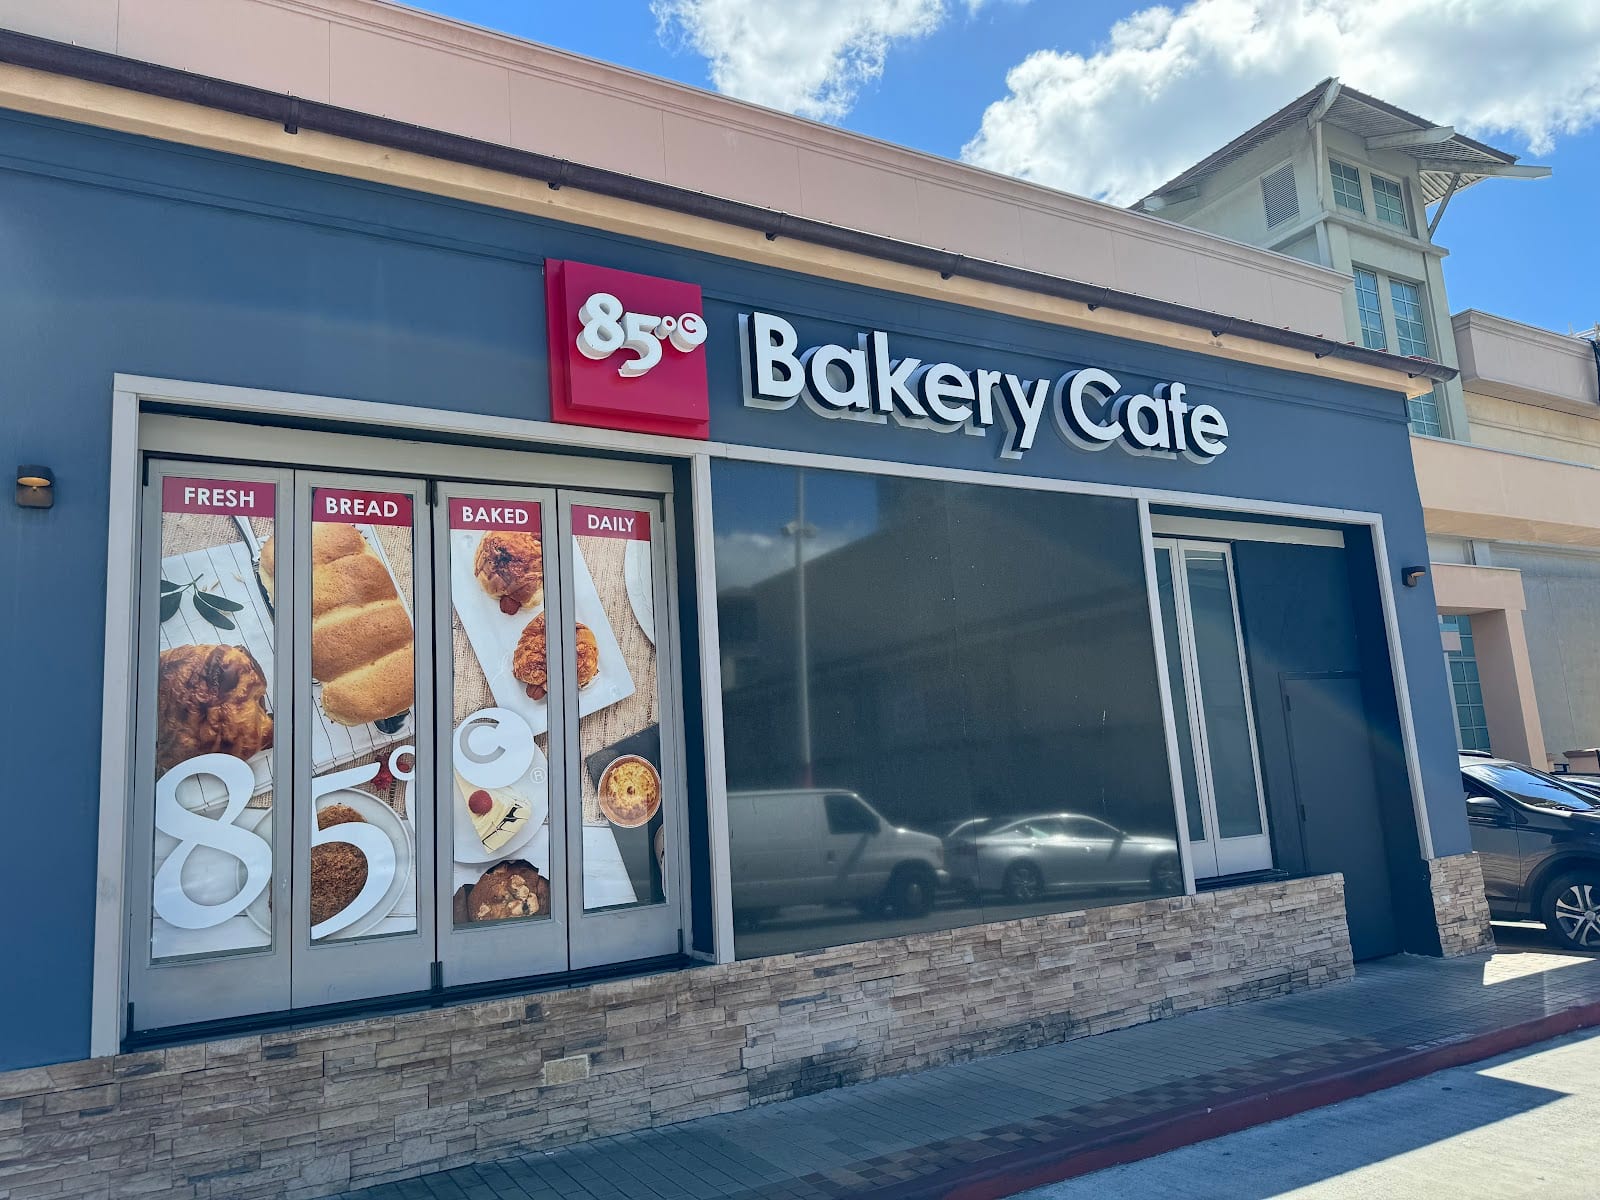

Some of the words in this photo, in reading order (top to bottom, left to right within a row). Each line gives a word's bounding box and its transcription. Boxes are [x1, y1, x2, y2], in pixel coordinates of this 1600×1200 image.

[747, 311, 1050, 452] Bakery
[1065, 367, 1229, 457] Cafe
[184, 487, 255, 508] FRESH
[325, 496, 399, 518] BREAD
[461, 506, 529, 525] BAKED
[587, 514, 635, 533] DAILY
